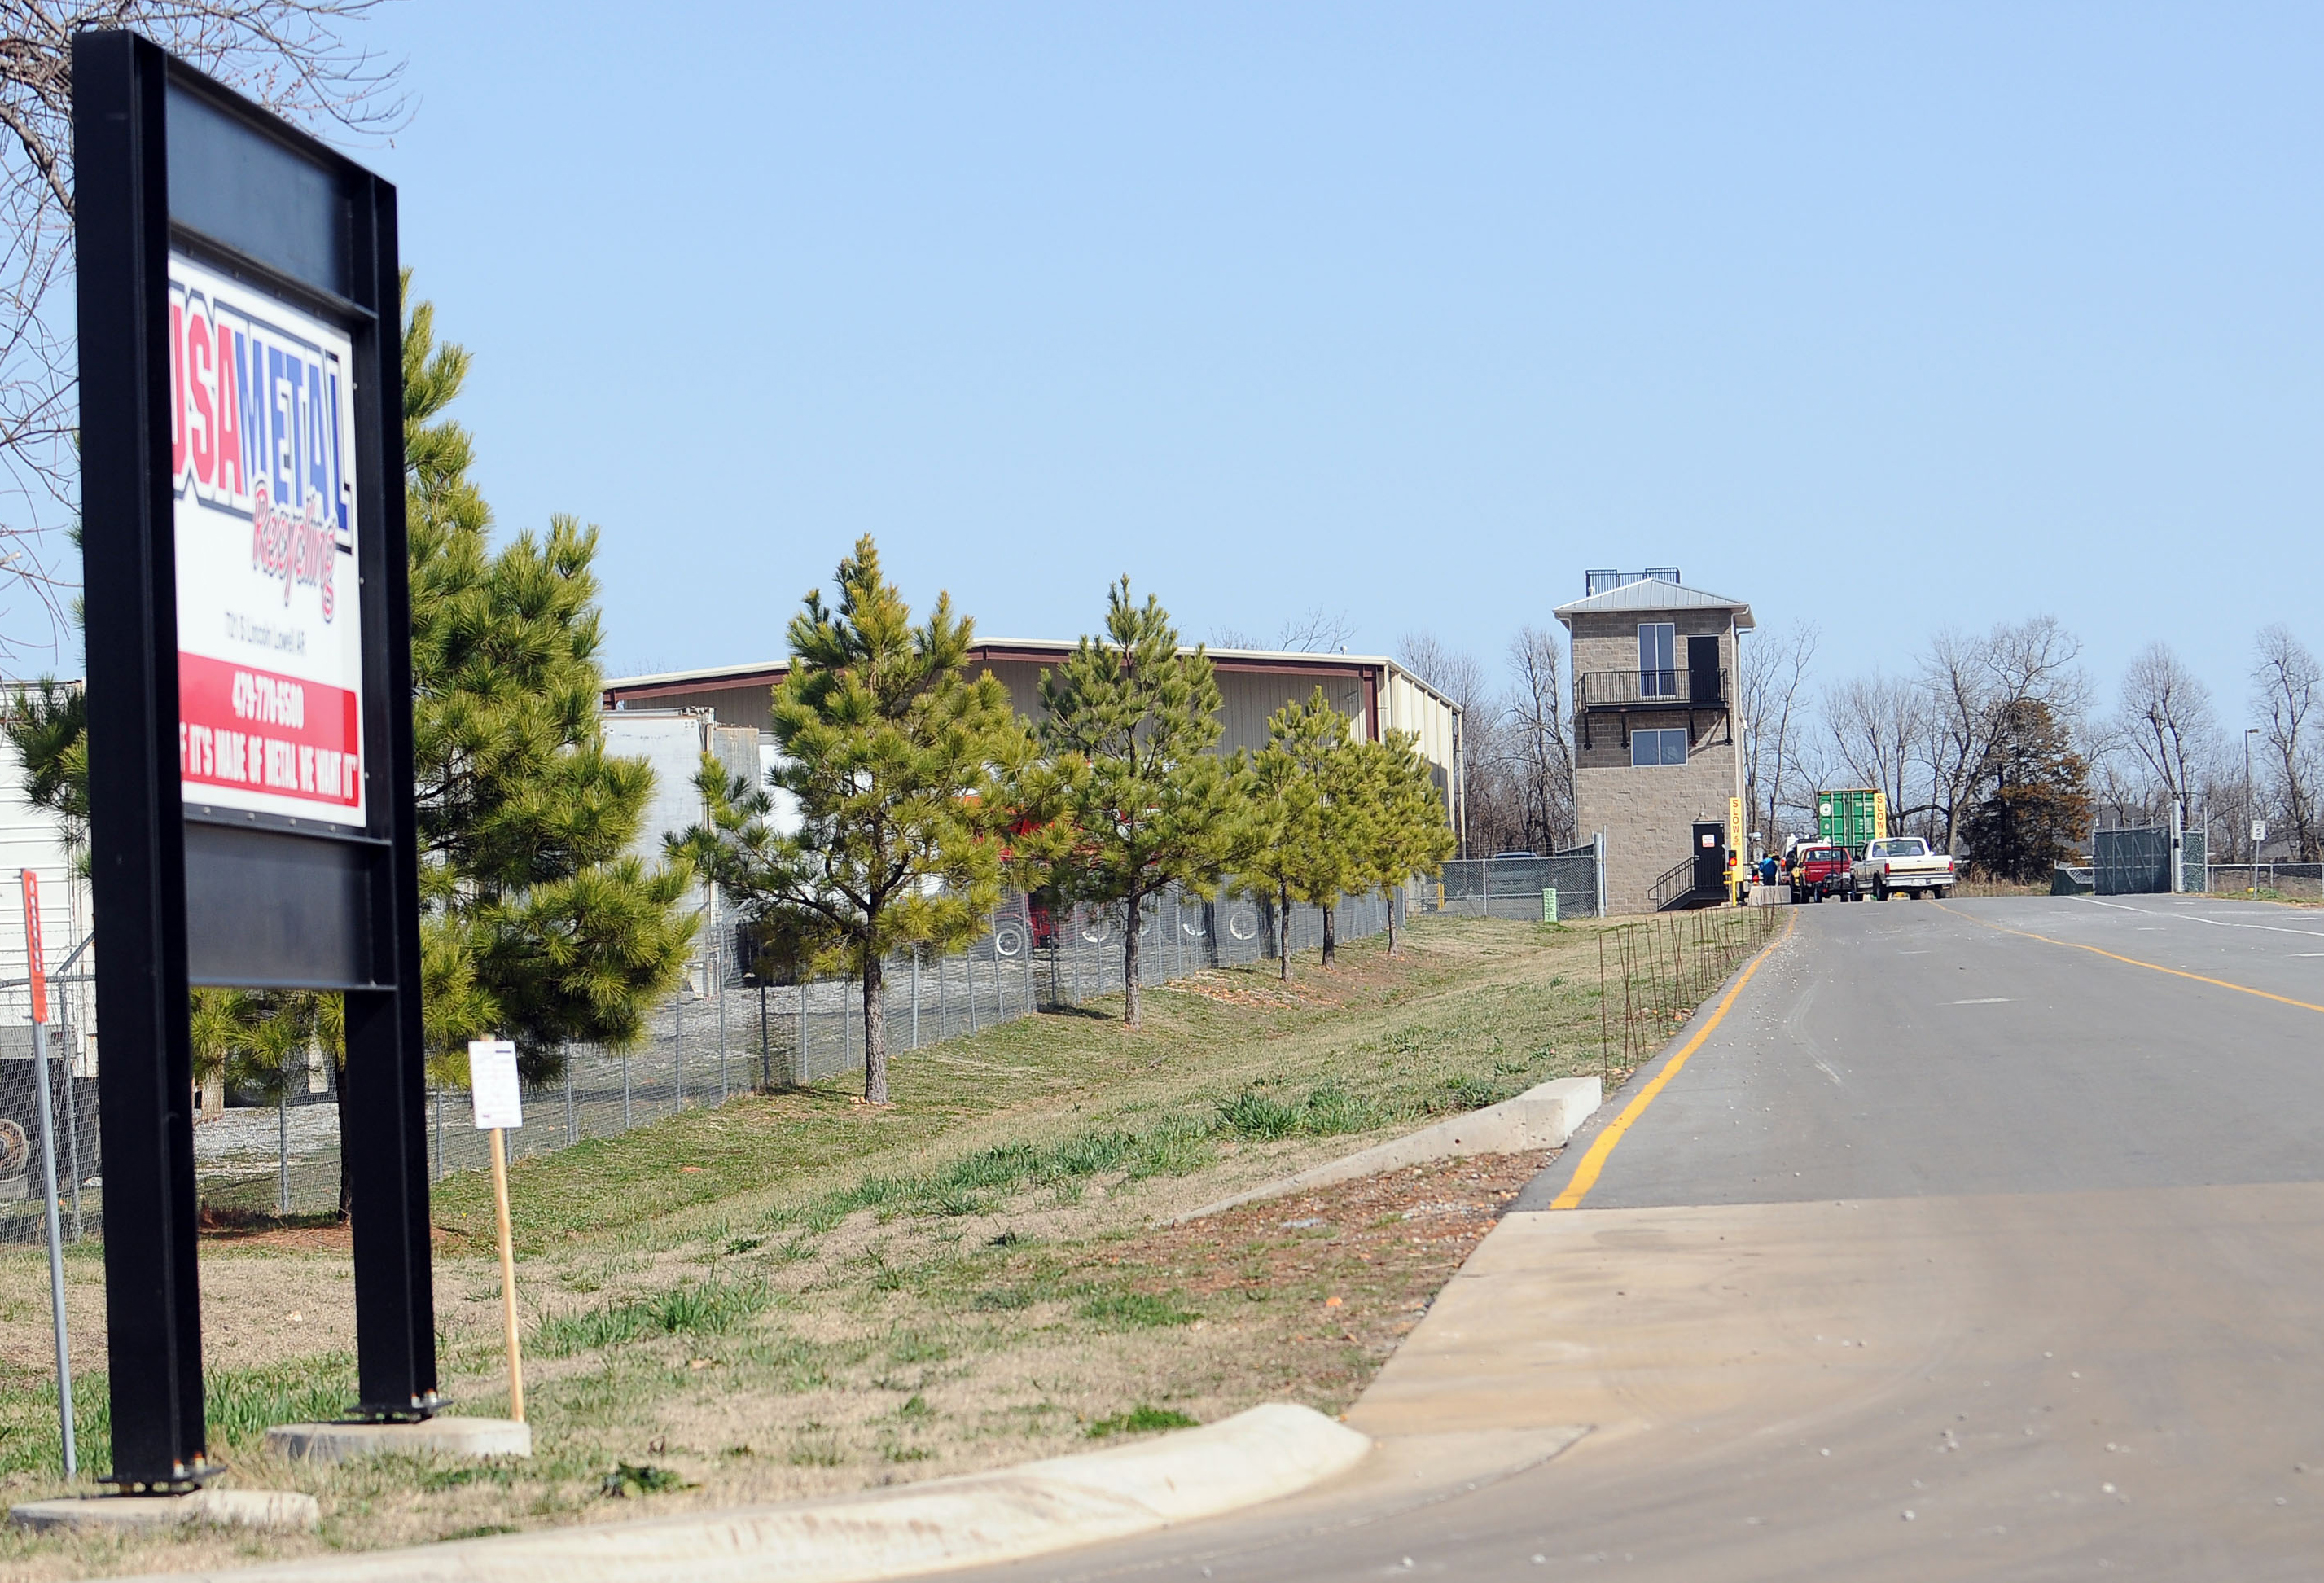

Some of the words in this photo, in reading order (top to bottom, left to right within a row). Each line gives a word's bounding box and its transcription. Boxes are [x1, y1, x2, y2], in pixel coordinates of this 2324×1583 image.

[235, 330, 349, 531] METAL
[252, 485, 337, 624] Recycling
[214, 728, 247, 783] MADE
[248, 734, 263, 784] OF
[264, 738, 299, 791] METAL
[315, 748, 342, 797] WANT
[1732, 799, 1740, 833] SLOW
